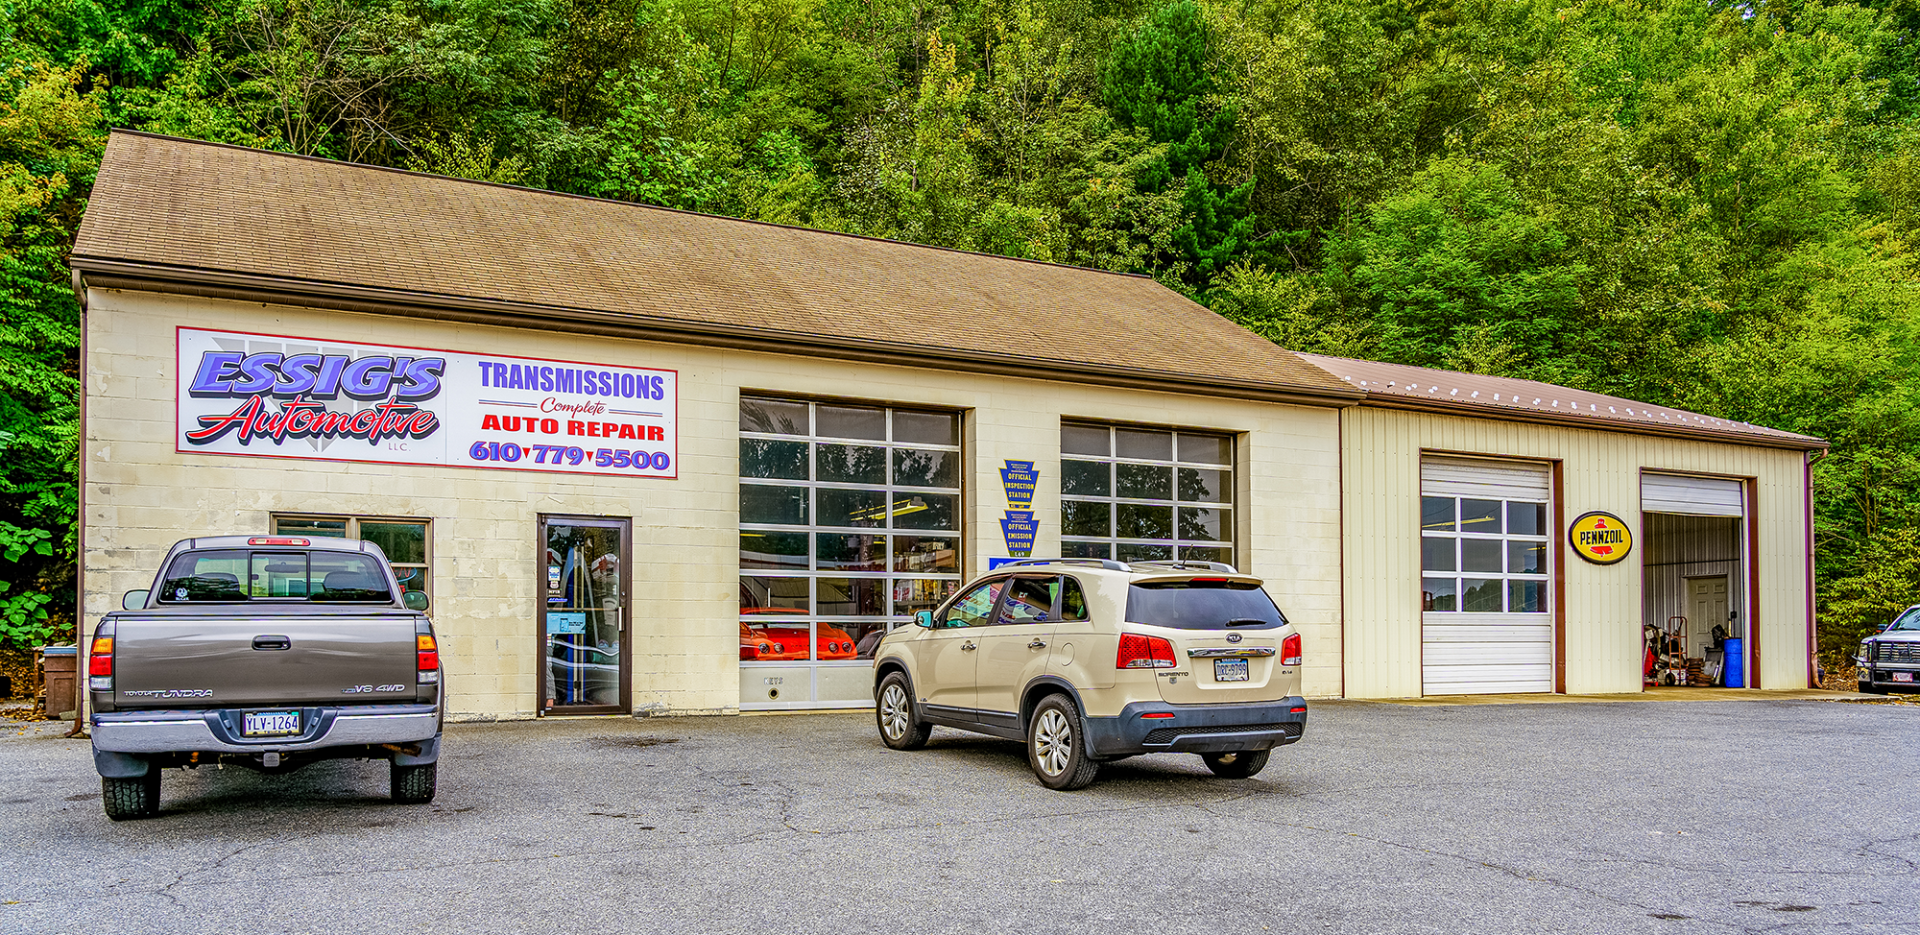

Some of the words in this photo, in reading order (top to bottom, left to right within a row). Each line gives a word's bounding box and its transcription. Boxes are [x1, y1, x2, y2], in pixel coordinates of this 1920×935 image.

[188, 351, 446, 401] ESSIG'S
[478, 361, 665, 401] TRANSMISSIONS
[540, 397, 608, 419] Complete
[185, 394, 440, 446] Automotive
[481, 414, 559, 434] AUTO
[567, 420, 665, 441] REPAIR
[1580, 530, 1623, 545] PENNZOIL
[354, 684, 373, 693] V6
[375, 684, 405, 692] 4WD
[763, 676, 783, 685] KEYS
[151, 689, 213, 698] TUNDRA
[246, 716, 298, 731] YLV-1264
